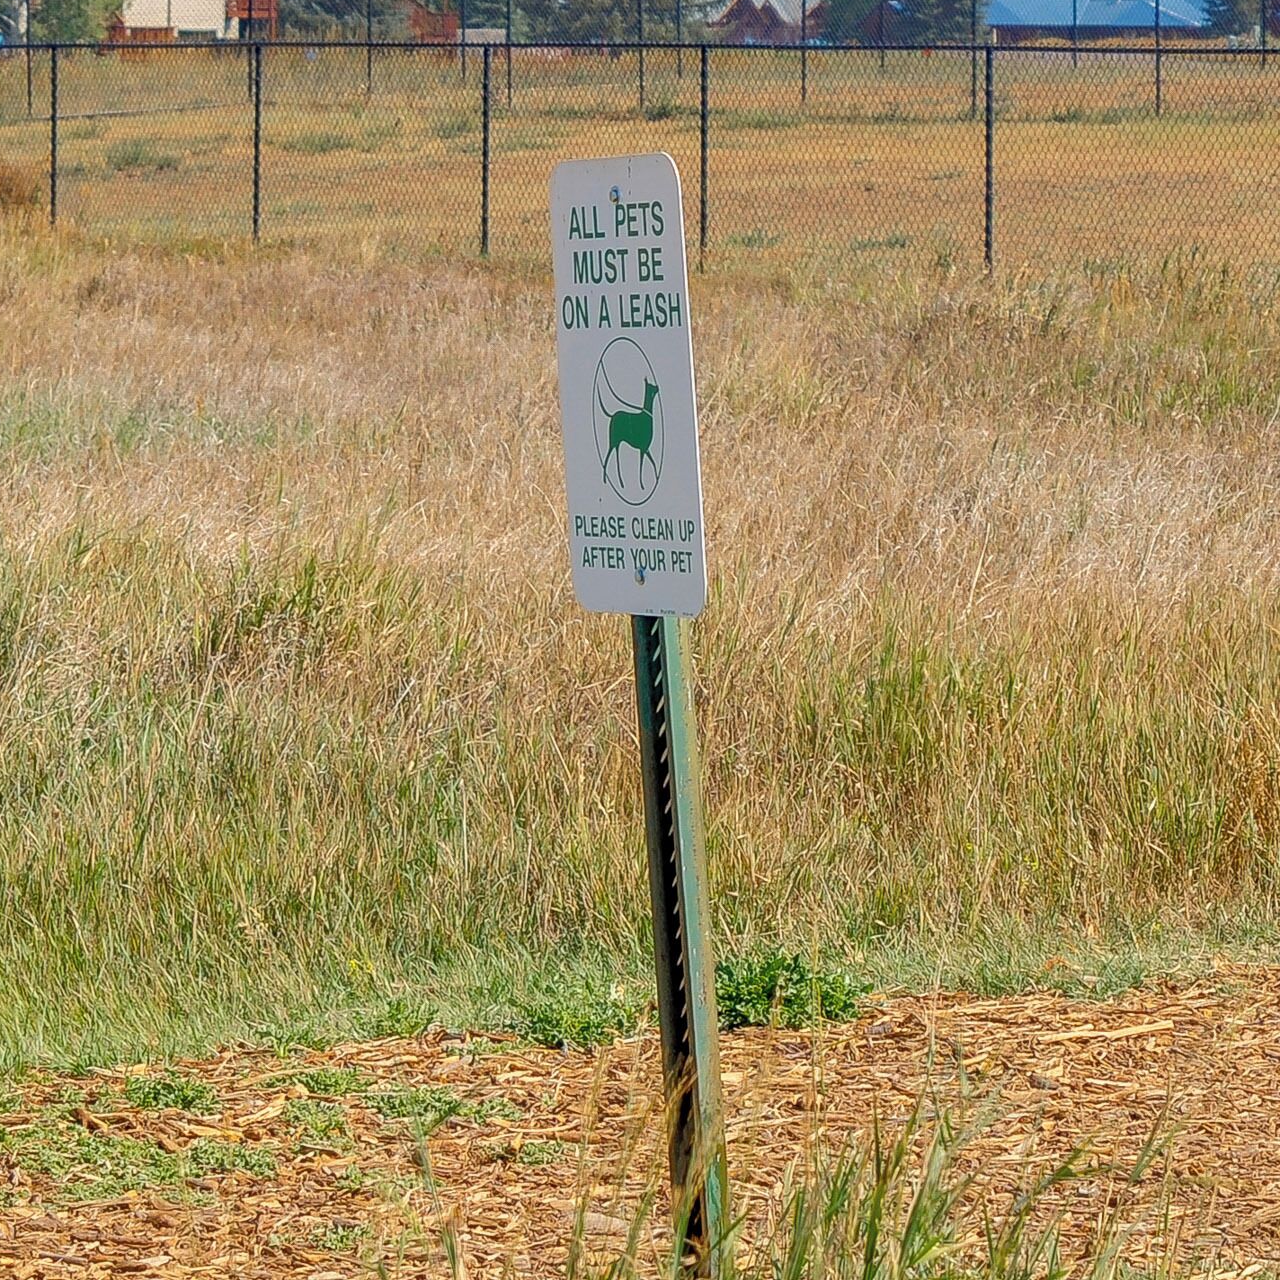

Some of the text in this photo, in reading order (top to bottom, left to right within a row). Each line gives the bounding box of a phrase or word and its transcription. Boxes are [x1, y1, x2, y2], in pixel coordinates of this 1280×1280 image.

[569, 200, 664, 240] ALL PETS
[573, 247, 664, 284] MUST BE
[562, 292, 682, 329] ON A LEASH
[575, 515, 695, 542] PLEASE CLEAN UP
[582, 546, 692, 573] AFTER YOUR PET
